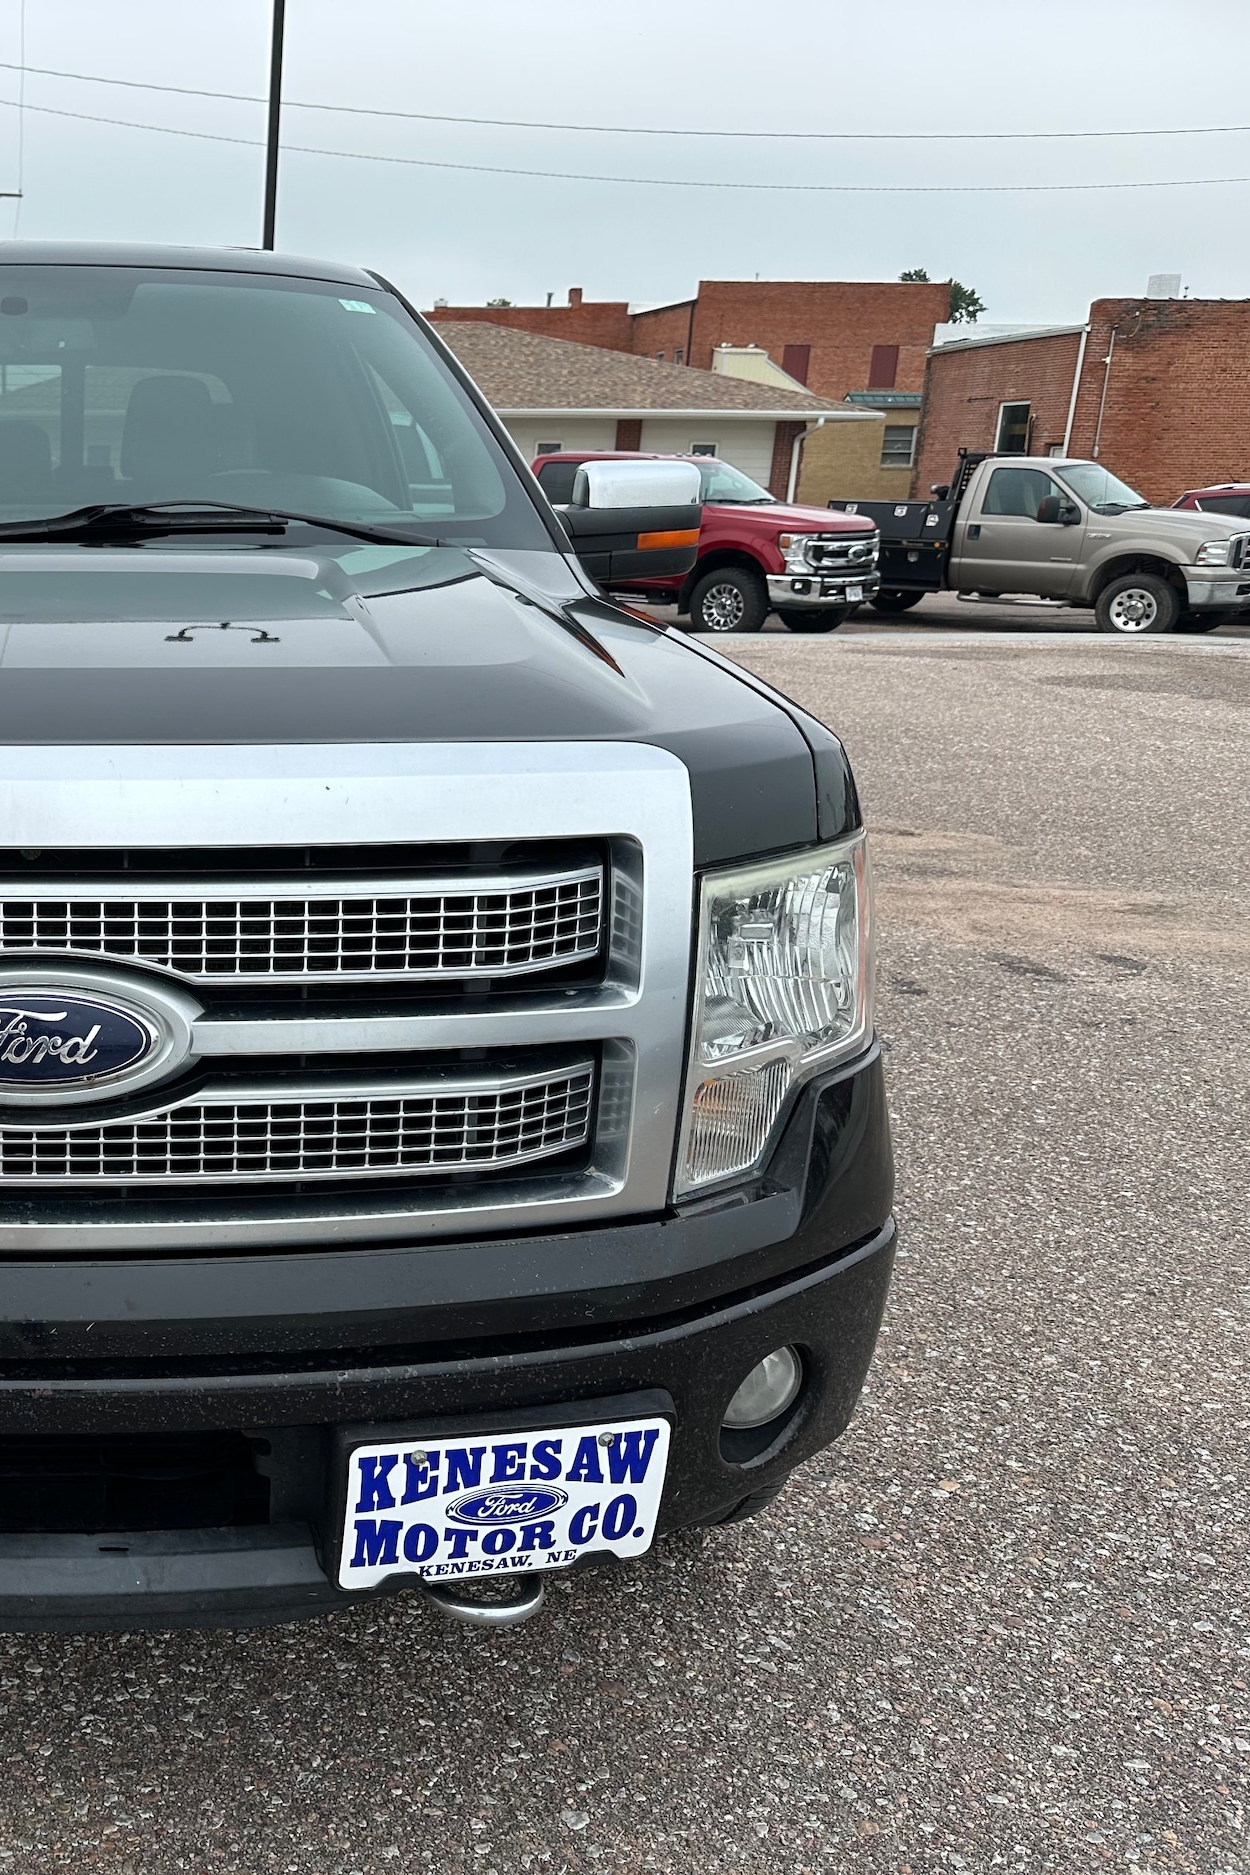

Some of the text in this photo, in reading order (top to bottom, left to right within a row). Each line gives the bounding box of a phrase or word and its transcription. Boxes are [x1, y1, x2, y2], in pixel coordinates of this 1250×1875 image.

[355, 1429, 659, 1513] KENESAW
[350, 1493, 644, 1568] MOTOR CO.
[477, 1493, 538, 1517] Ford
[418, 1549, 578, 1577] KENESAW, NE
